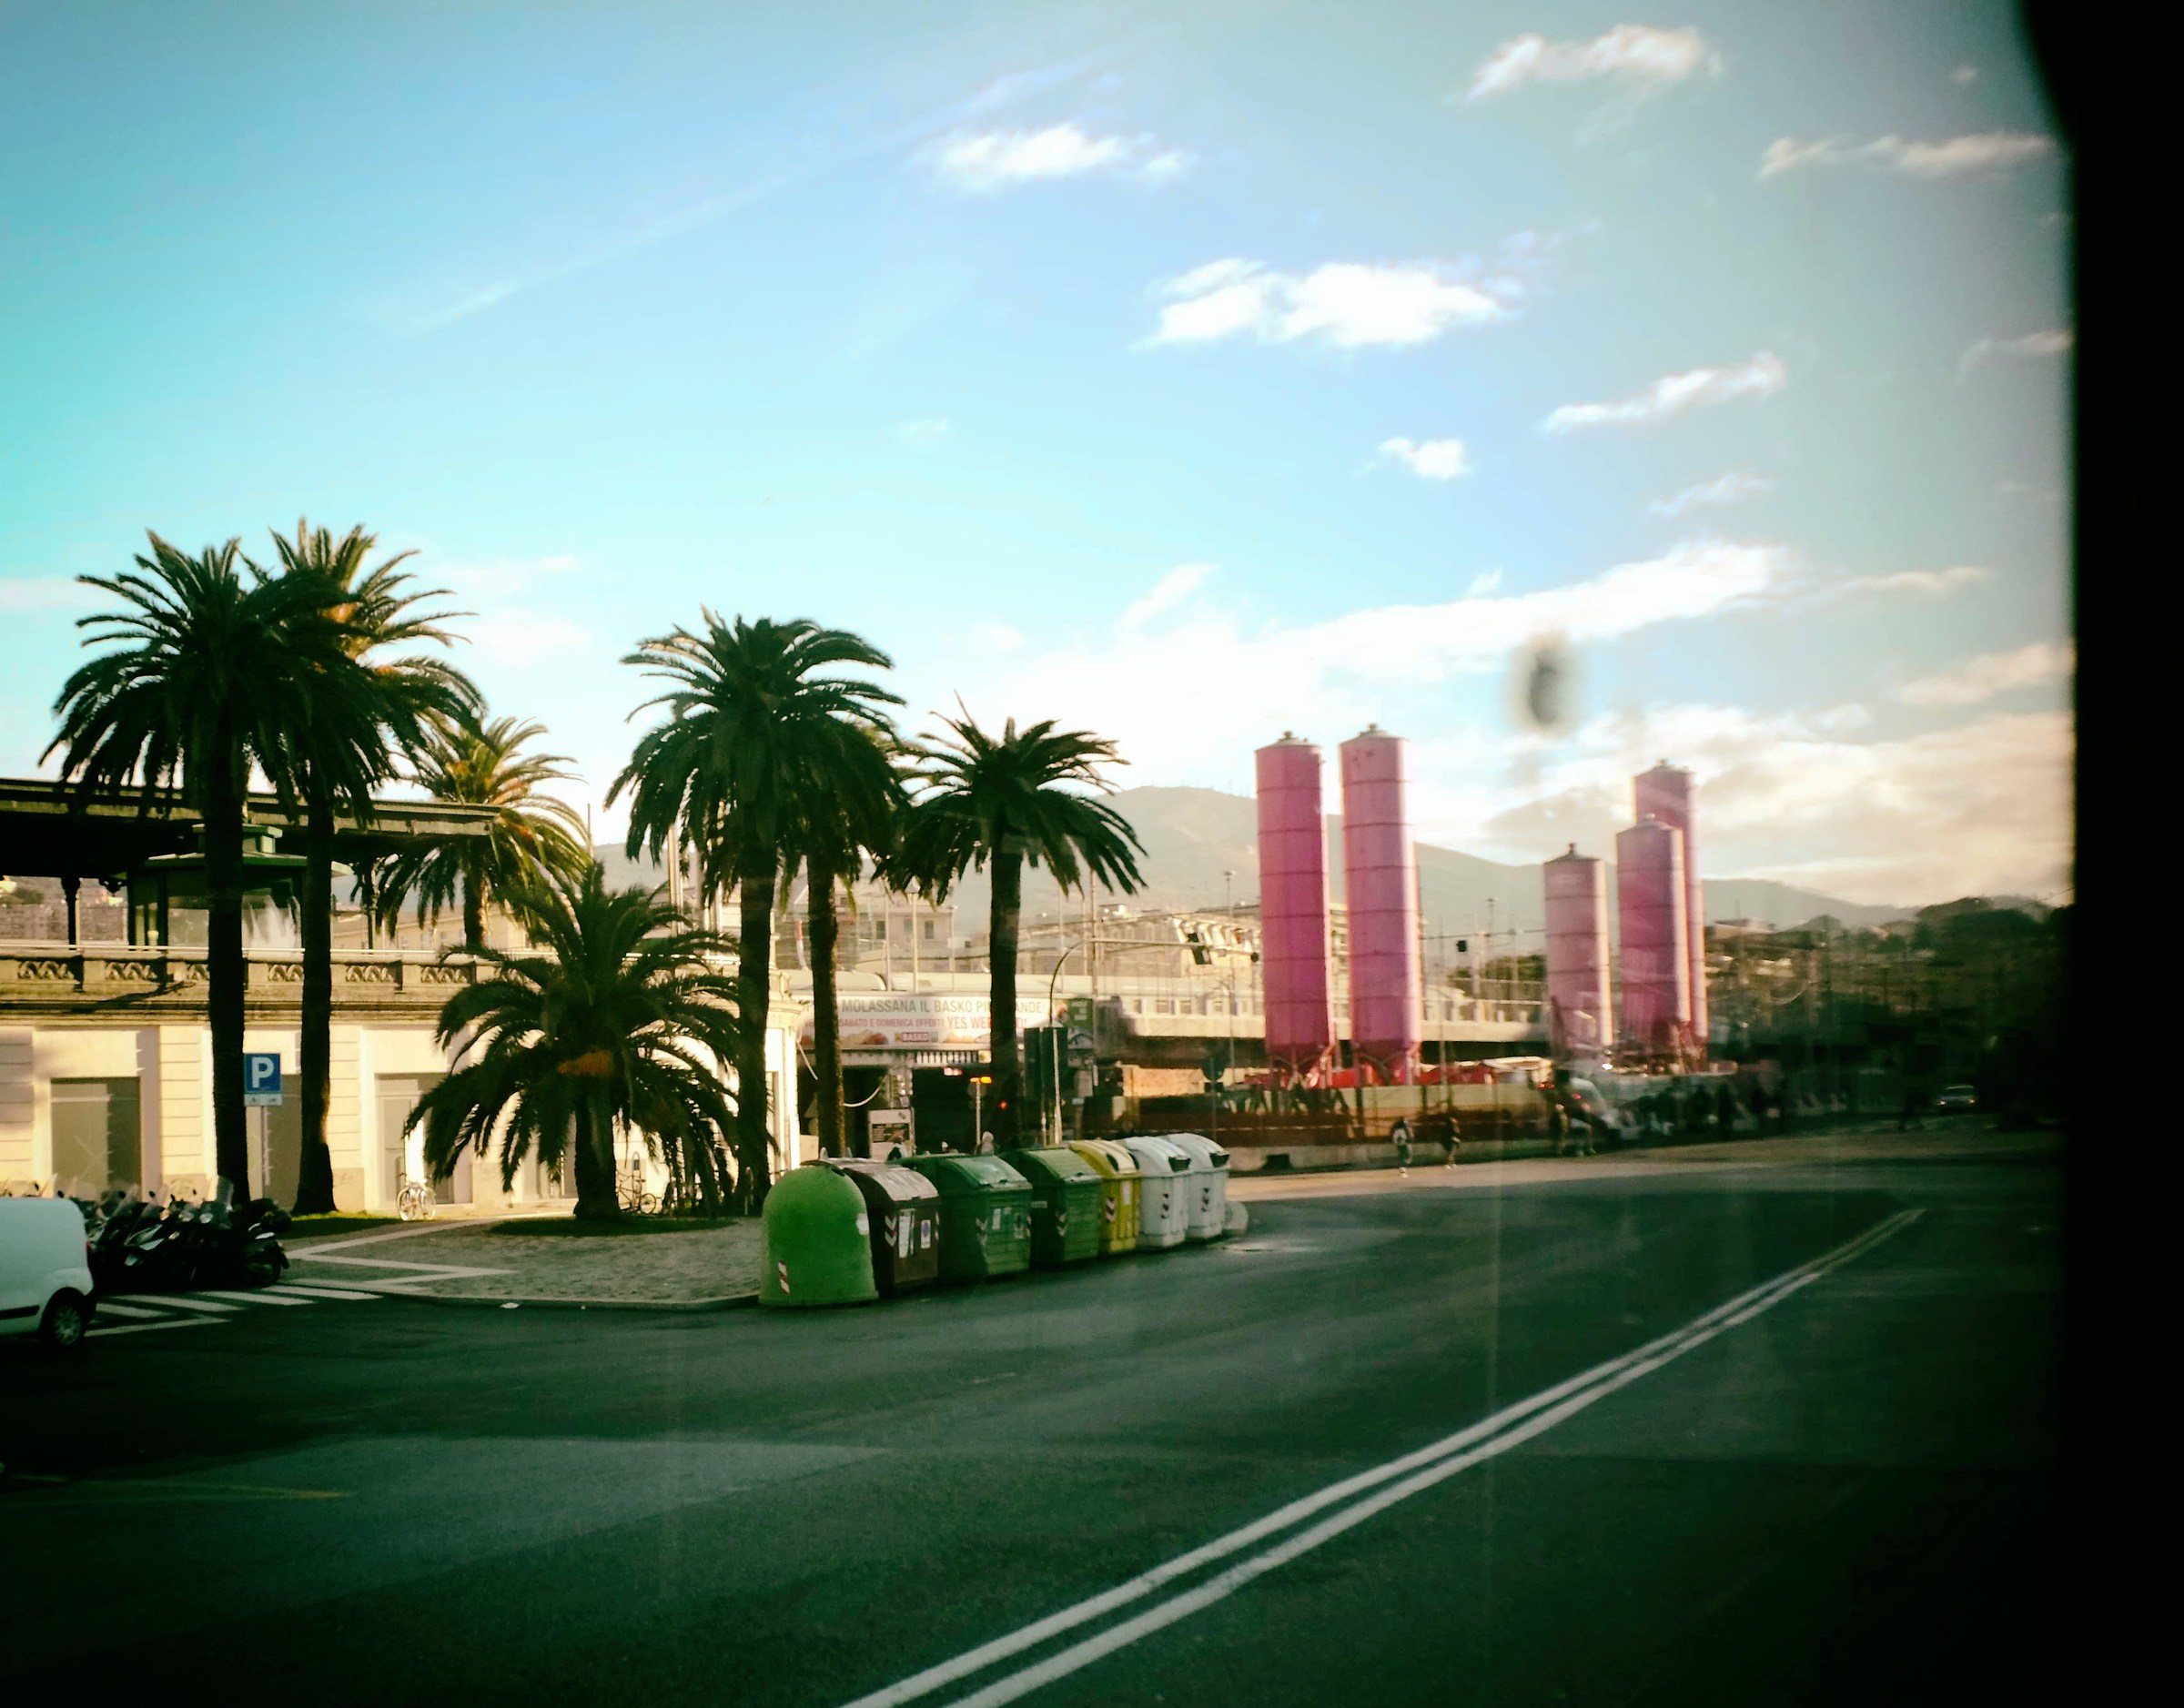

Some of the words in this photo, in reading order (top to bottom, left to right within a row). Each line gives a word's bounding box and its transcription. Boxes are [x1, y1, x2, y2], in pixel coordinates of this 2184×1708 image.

[842, 999, 915, 1013] MOLASSANA
[920, 999, 930, 1013] IL
[935, 1000, 972, 1013] BASKO
[838, 1018, 867, 1027] SABATO
[869, 1018, 875, 1027] E
[876, 1018, 914, 1027] DOMENICA
[915, 1018, 945, 1027] OFFERTE
[947, 1016, 967, 1029] YES
[903, 1032, 929, 1042] BASKO
[251, 1056, 275, 1088] P
